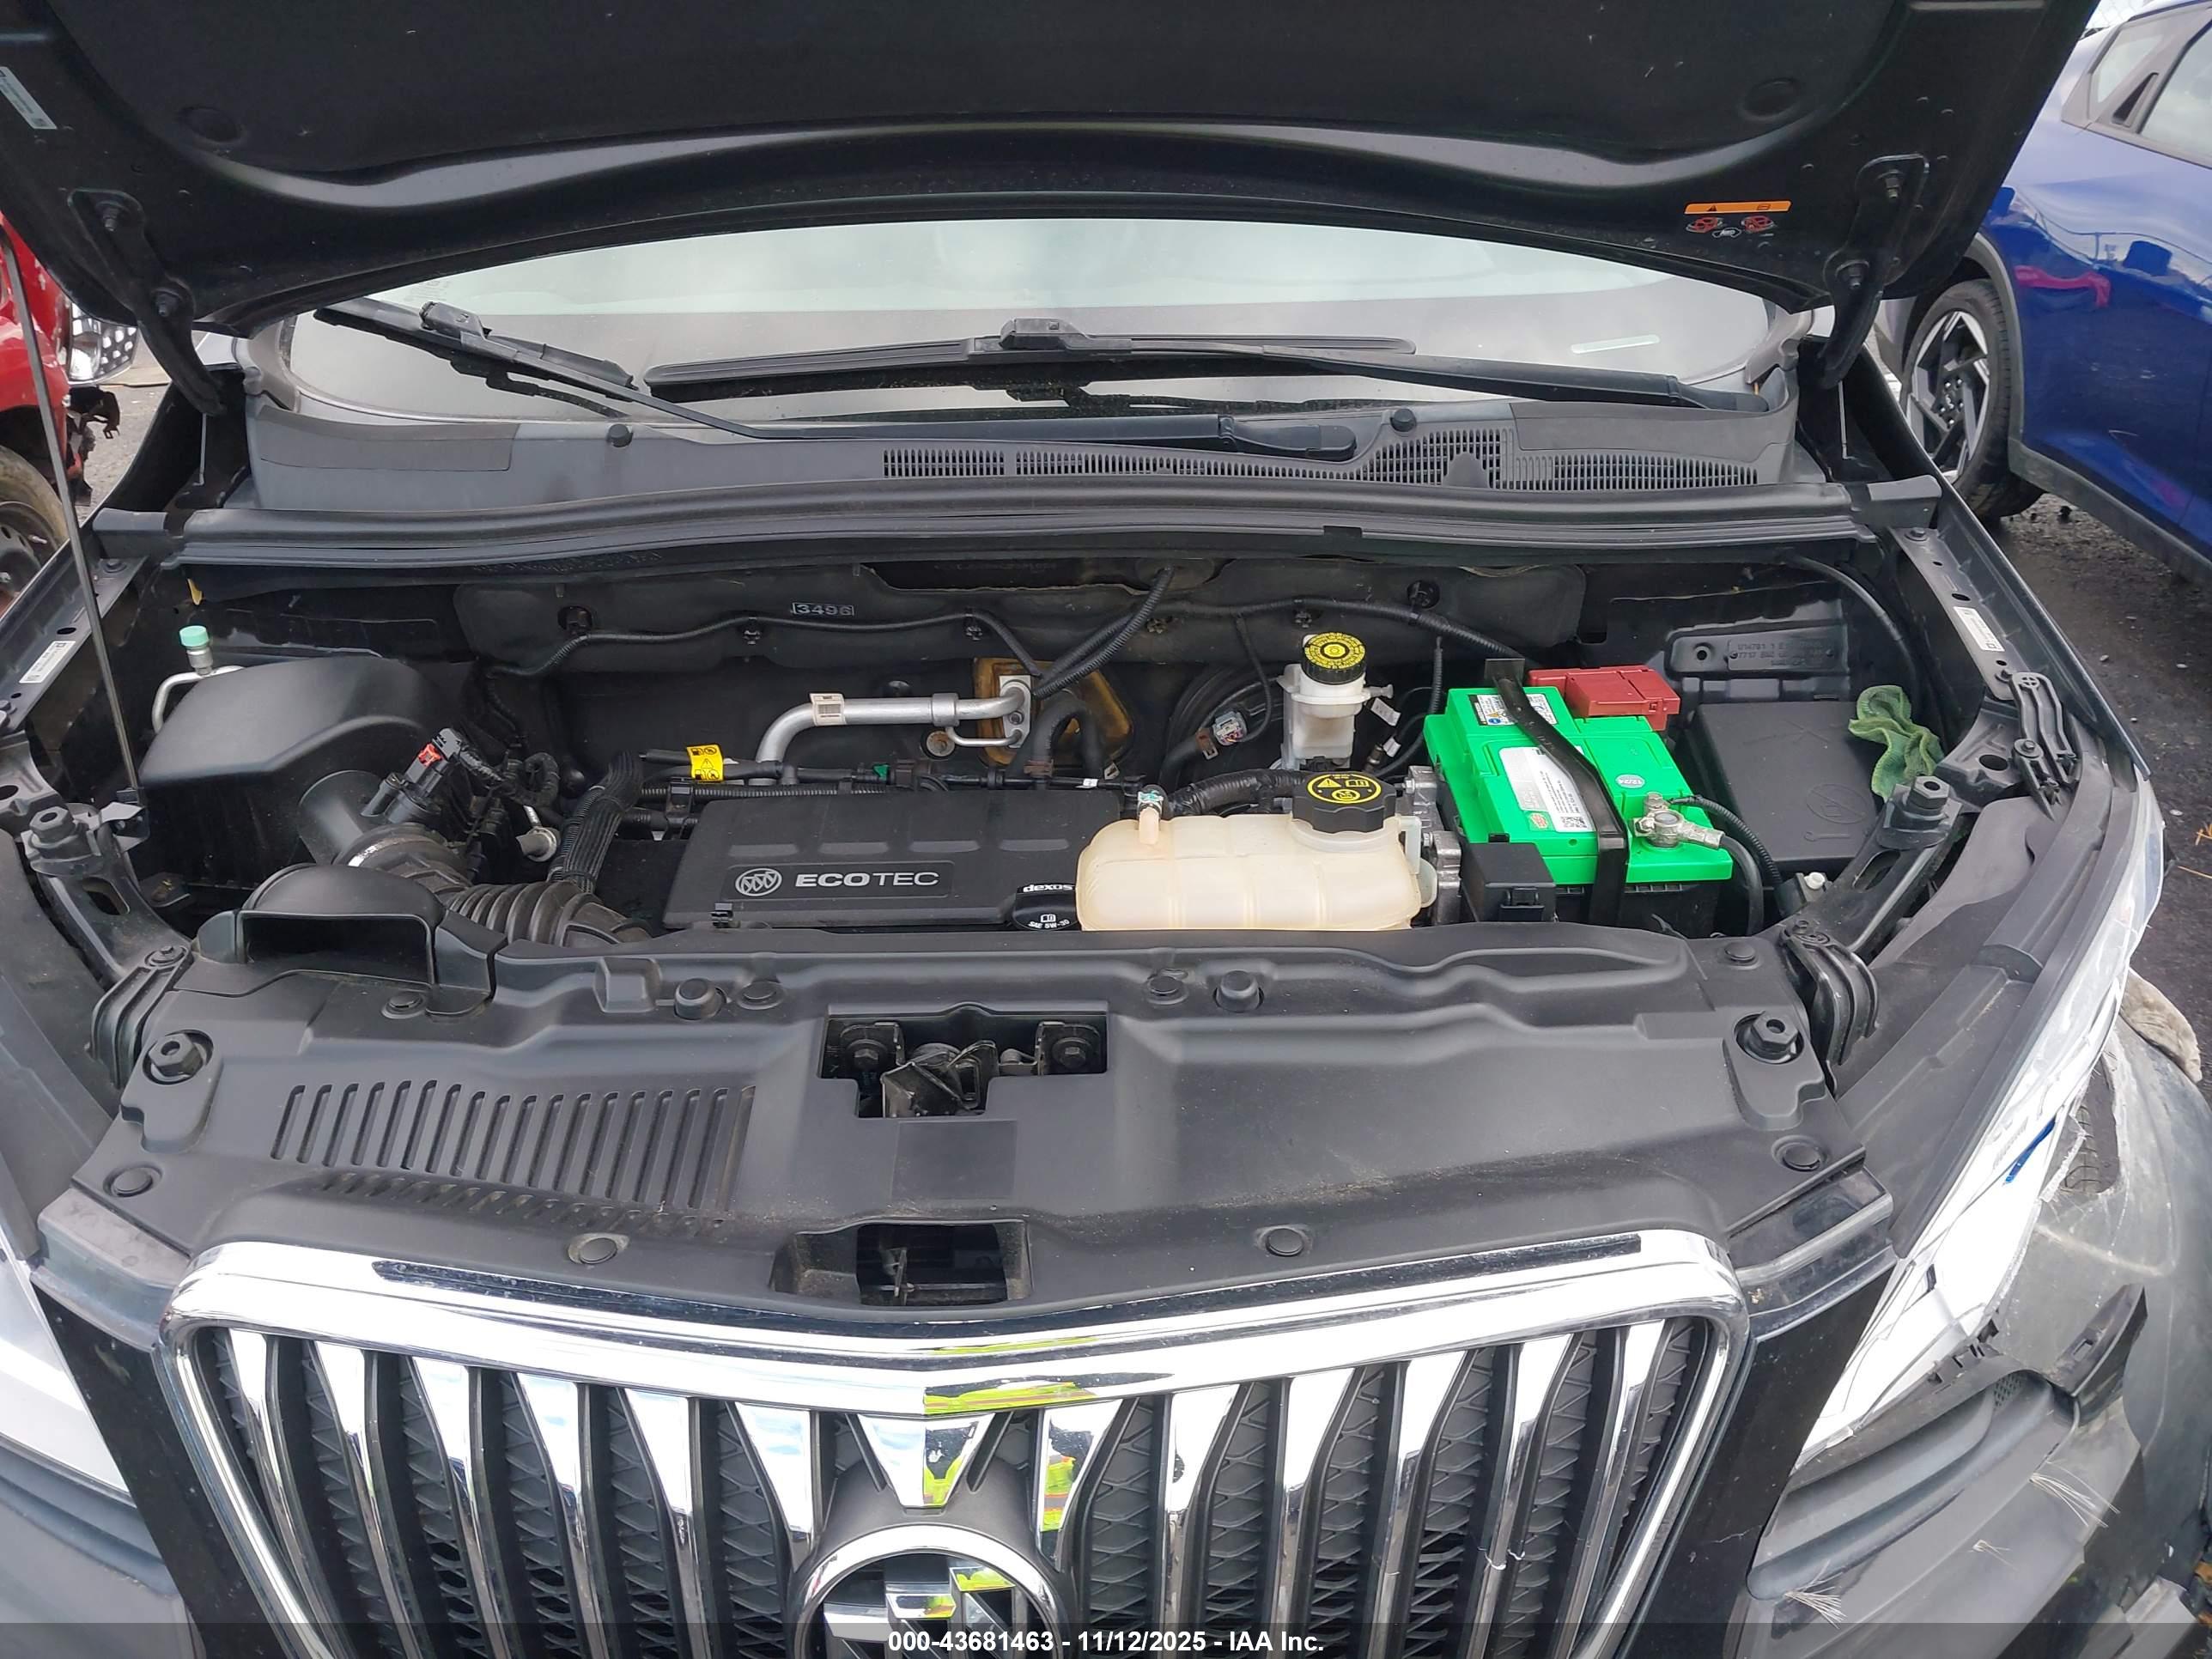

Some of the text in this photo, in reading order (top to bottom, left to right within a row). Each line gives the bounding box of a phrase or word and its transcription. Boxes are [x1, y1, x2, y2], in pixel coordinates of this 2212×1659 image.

[796, 604, 853, 615] 3496
[795, 872, 939, 887] ECOTEC
[1023, 884, 1075, 892] dexos
[1044, 919, 1070, 928] 5W-30
